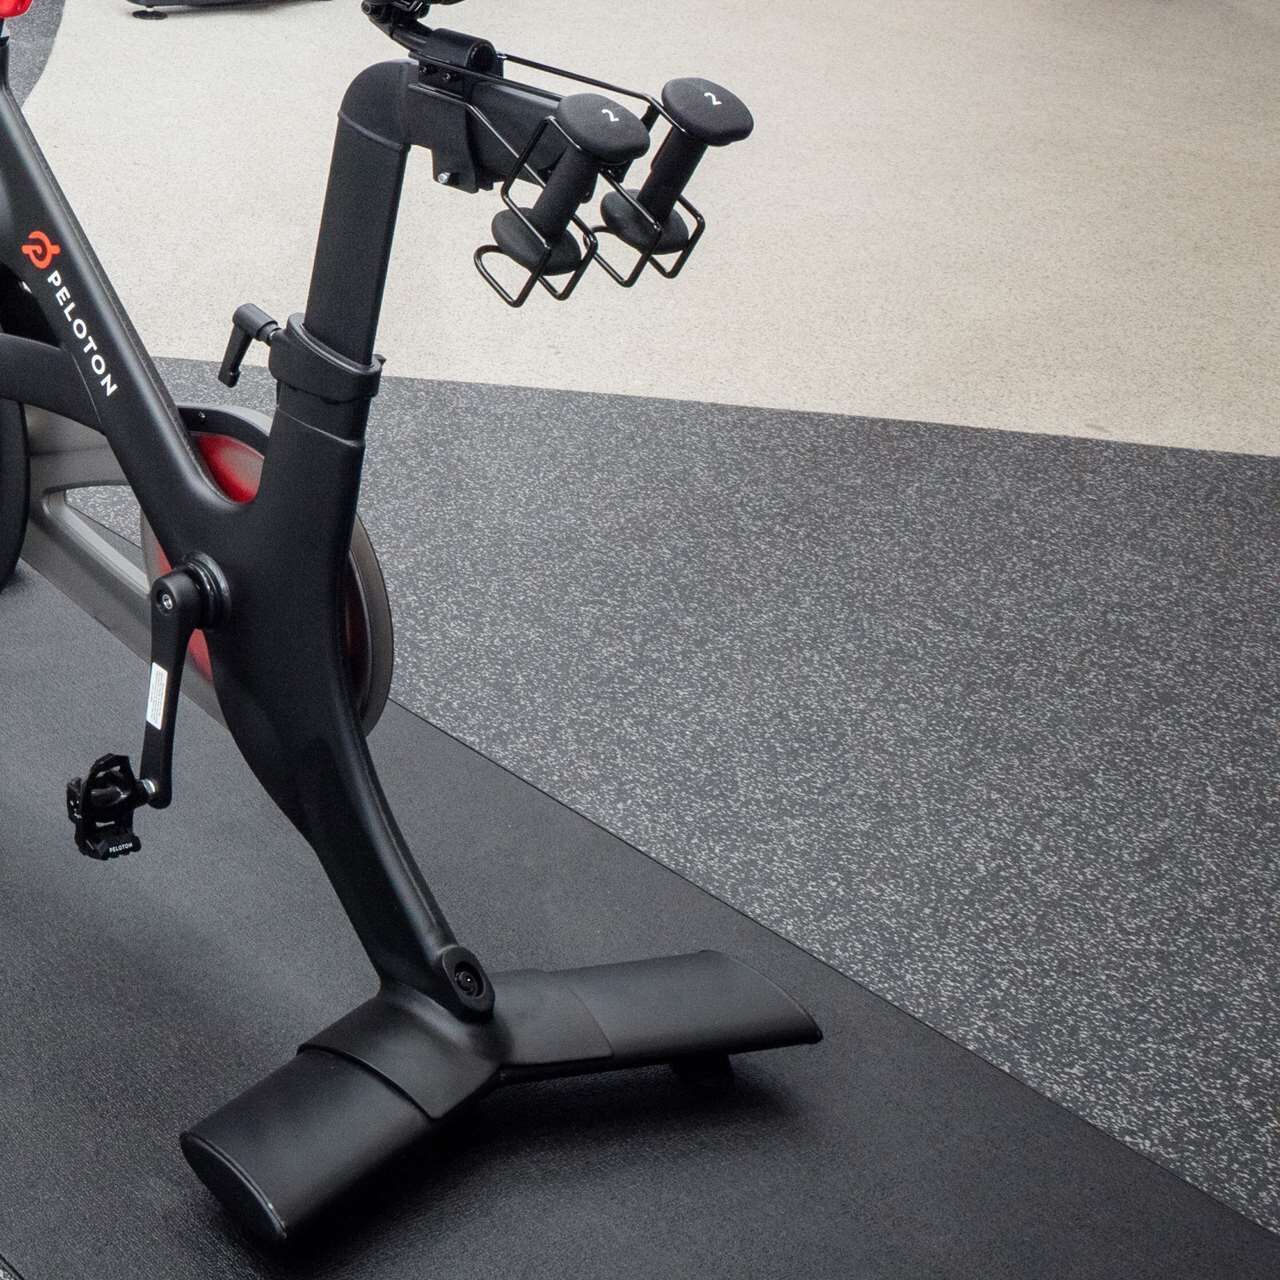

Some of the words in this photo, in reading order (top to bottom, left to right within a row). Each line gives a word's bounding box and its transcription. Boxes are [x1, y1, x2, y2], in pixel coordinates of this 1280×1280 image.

[704, 91, 722, 106] 2
[601, 108, 619, 122] 2
[46, 270, 119, 398] PELOTON
